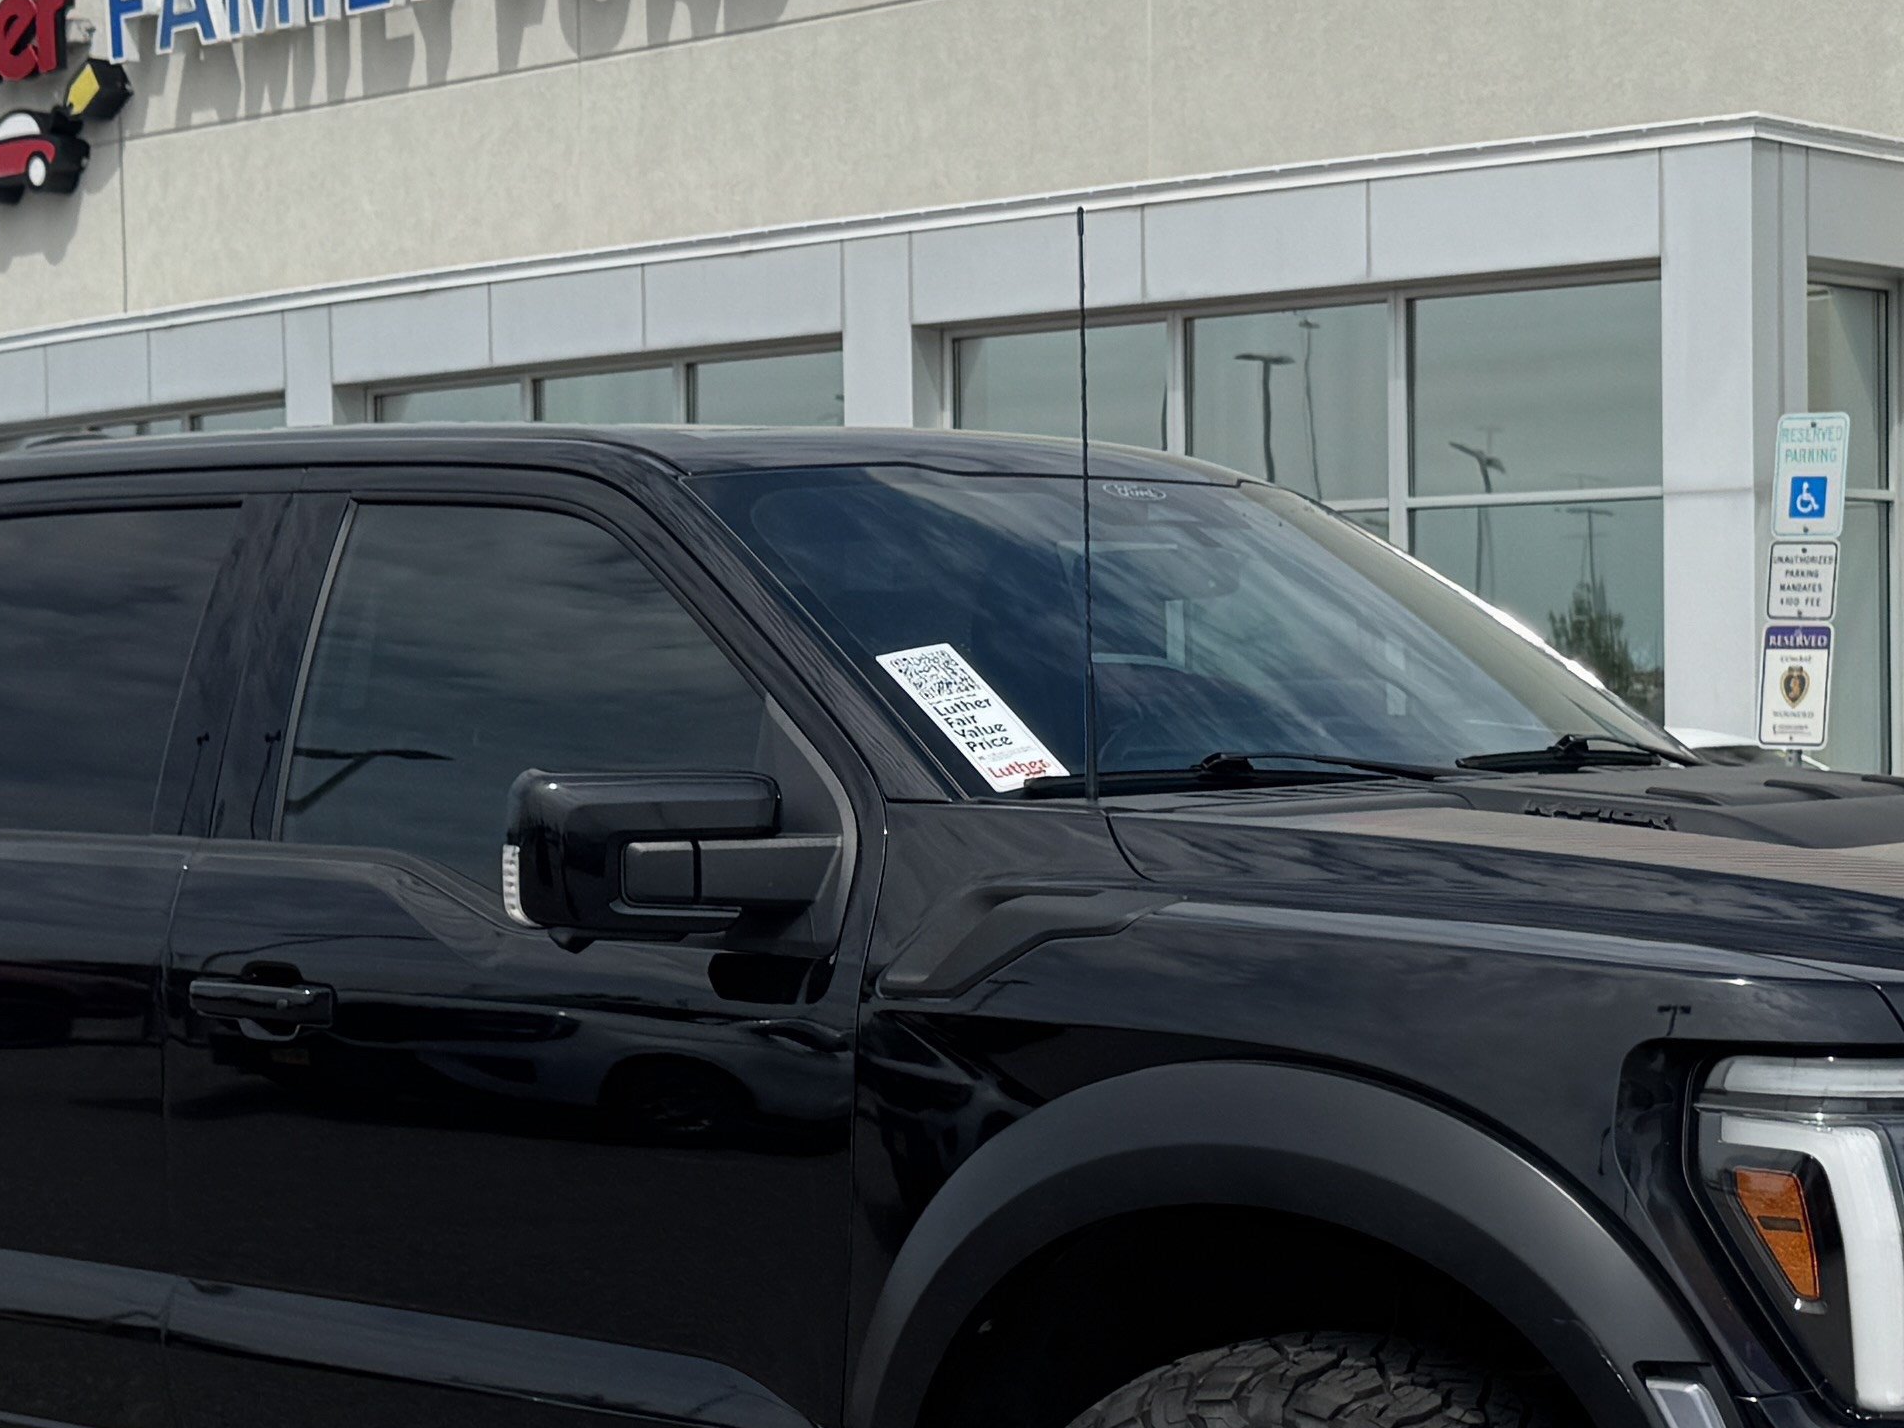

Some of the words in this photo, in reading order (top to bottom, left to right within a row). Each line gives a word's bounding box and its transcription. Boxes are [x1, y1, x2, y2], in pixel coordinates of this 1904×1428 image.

[1780, 425, 1844, 444] RESERVED
[1785, 447, 1838, 464] PARKING
[1773, 555, 1834, 565] UNAUTHORIZED
[1784, 569, 1820, 579] PARKING
[1779, 582, 1823, 593] MANDATES
[1768, 634, 1829, 648] RESERVED
[932, 698, 992, 717] Luther
[943, 714, 978, 729] Fair
[953, 723, 1007, 739] Value
[965, 736, 1013, 752] Price
[987, 759, 1046, 779] Luther
